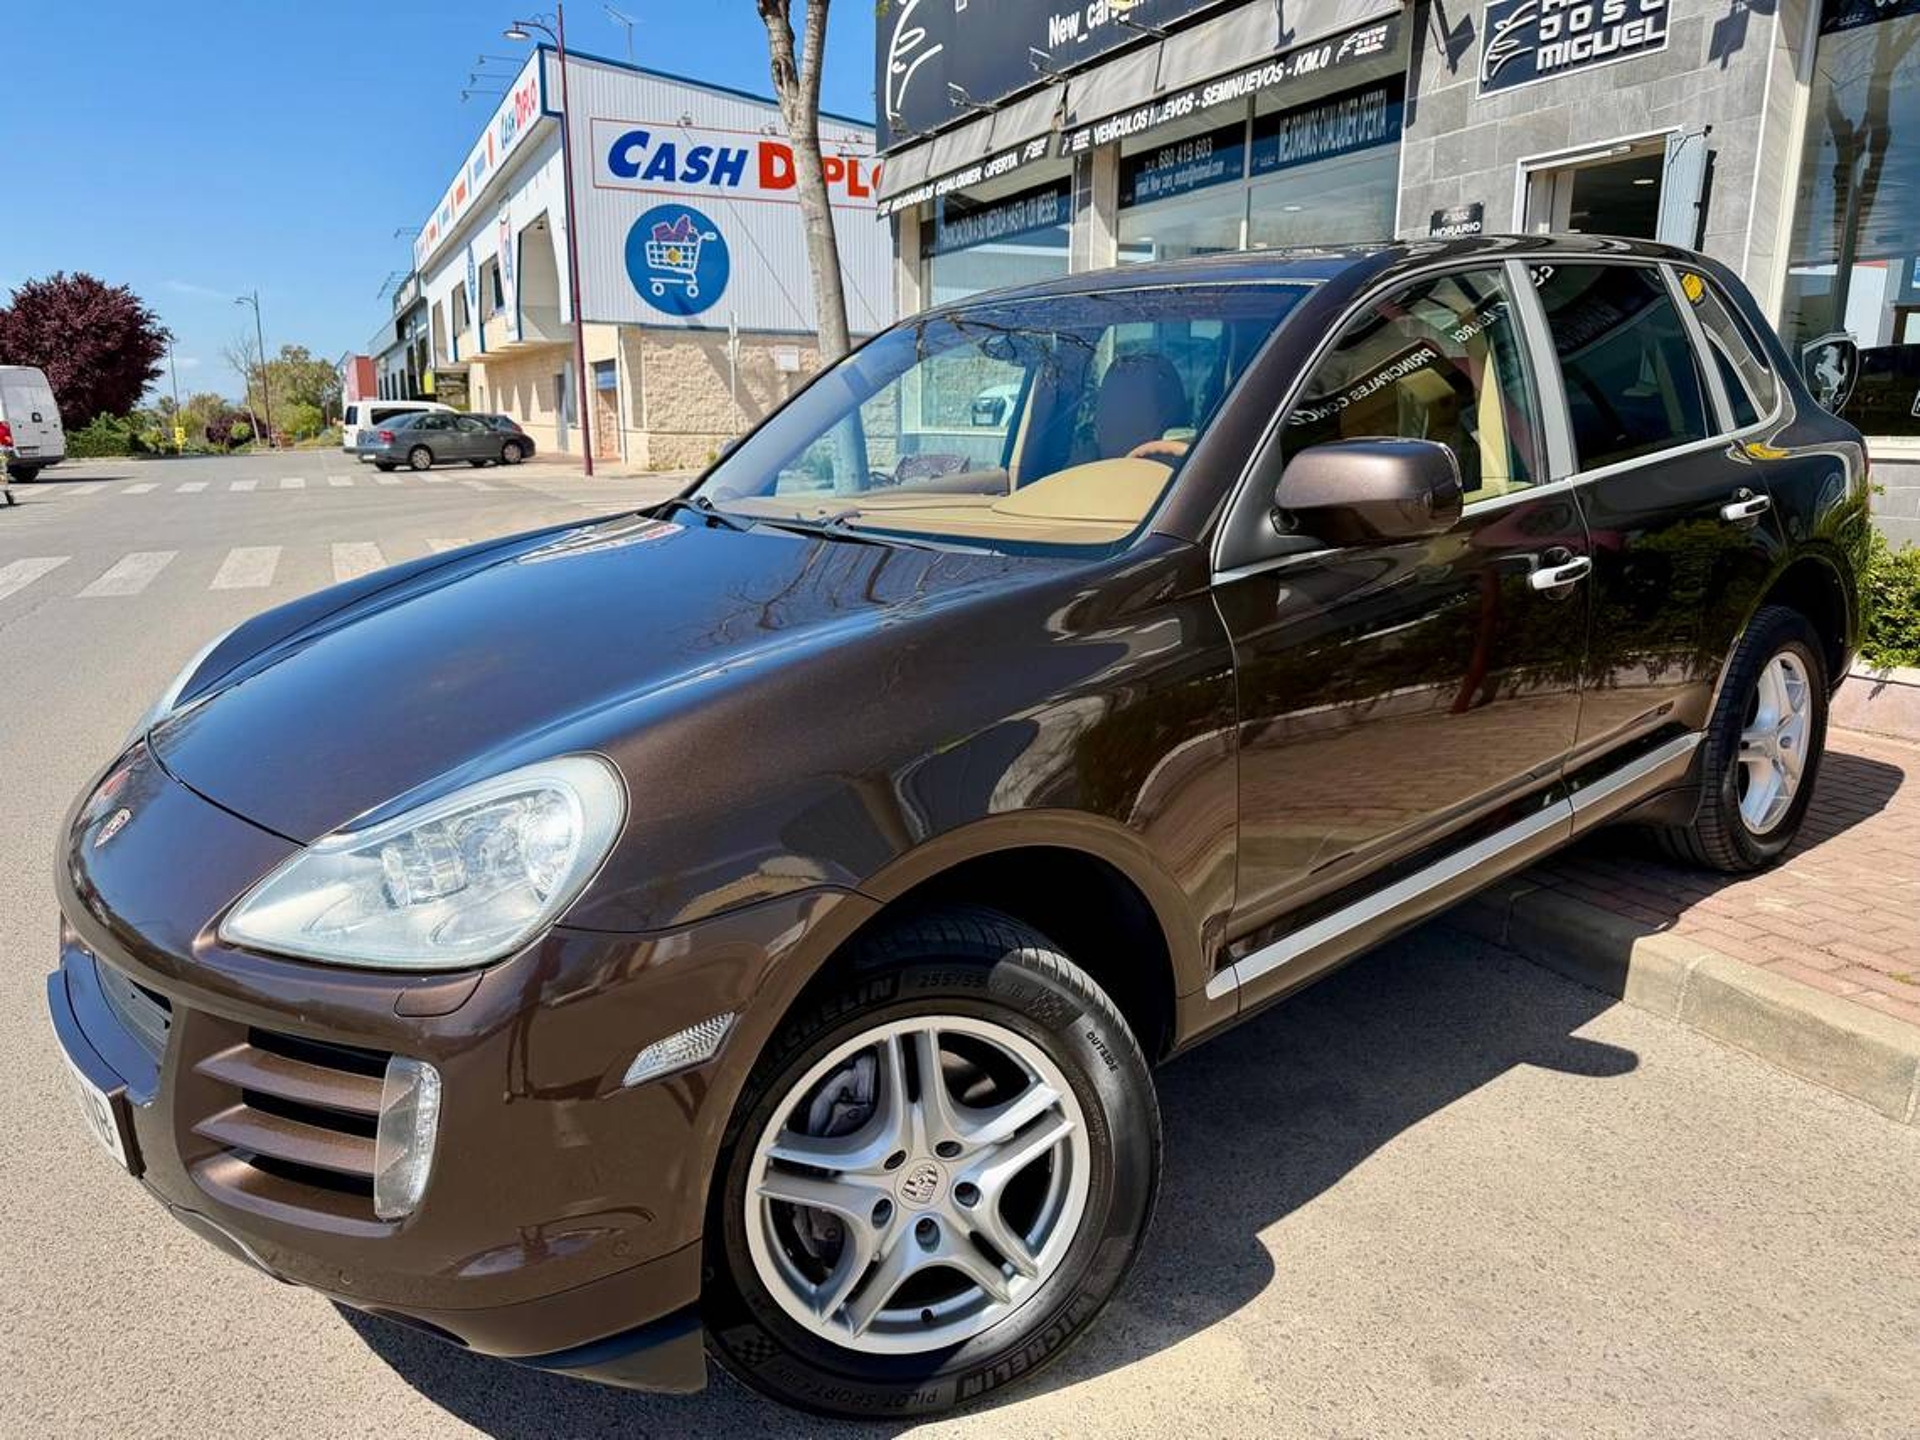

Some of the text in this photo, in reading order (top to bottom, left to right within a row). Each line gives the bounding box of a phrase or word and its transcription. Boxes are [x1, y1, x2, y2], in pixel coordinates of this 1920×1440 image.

[1537, 16, 1665, 71] MIGUEL
[1094, 108, 1148, 146] VEHÍCULOS
[1201, 62, 1284, 108] SEMINUEVOS
[1293, 45, 1331, 77] KM.0
[608, 130, 883, 199] CASH DPL
[935, 166, 982, 196] CUALQUIER
[984, 151, 1018, 178] OFERTA
[1086, 1031, 1119, 1072] OUTSIDE
